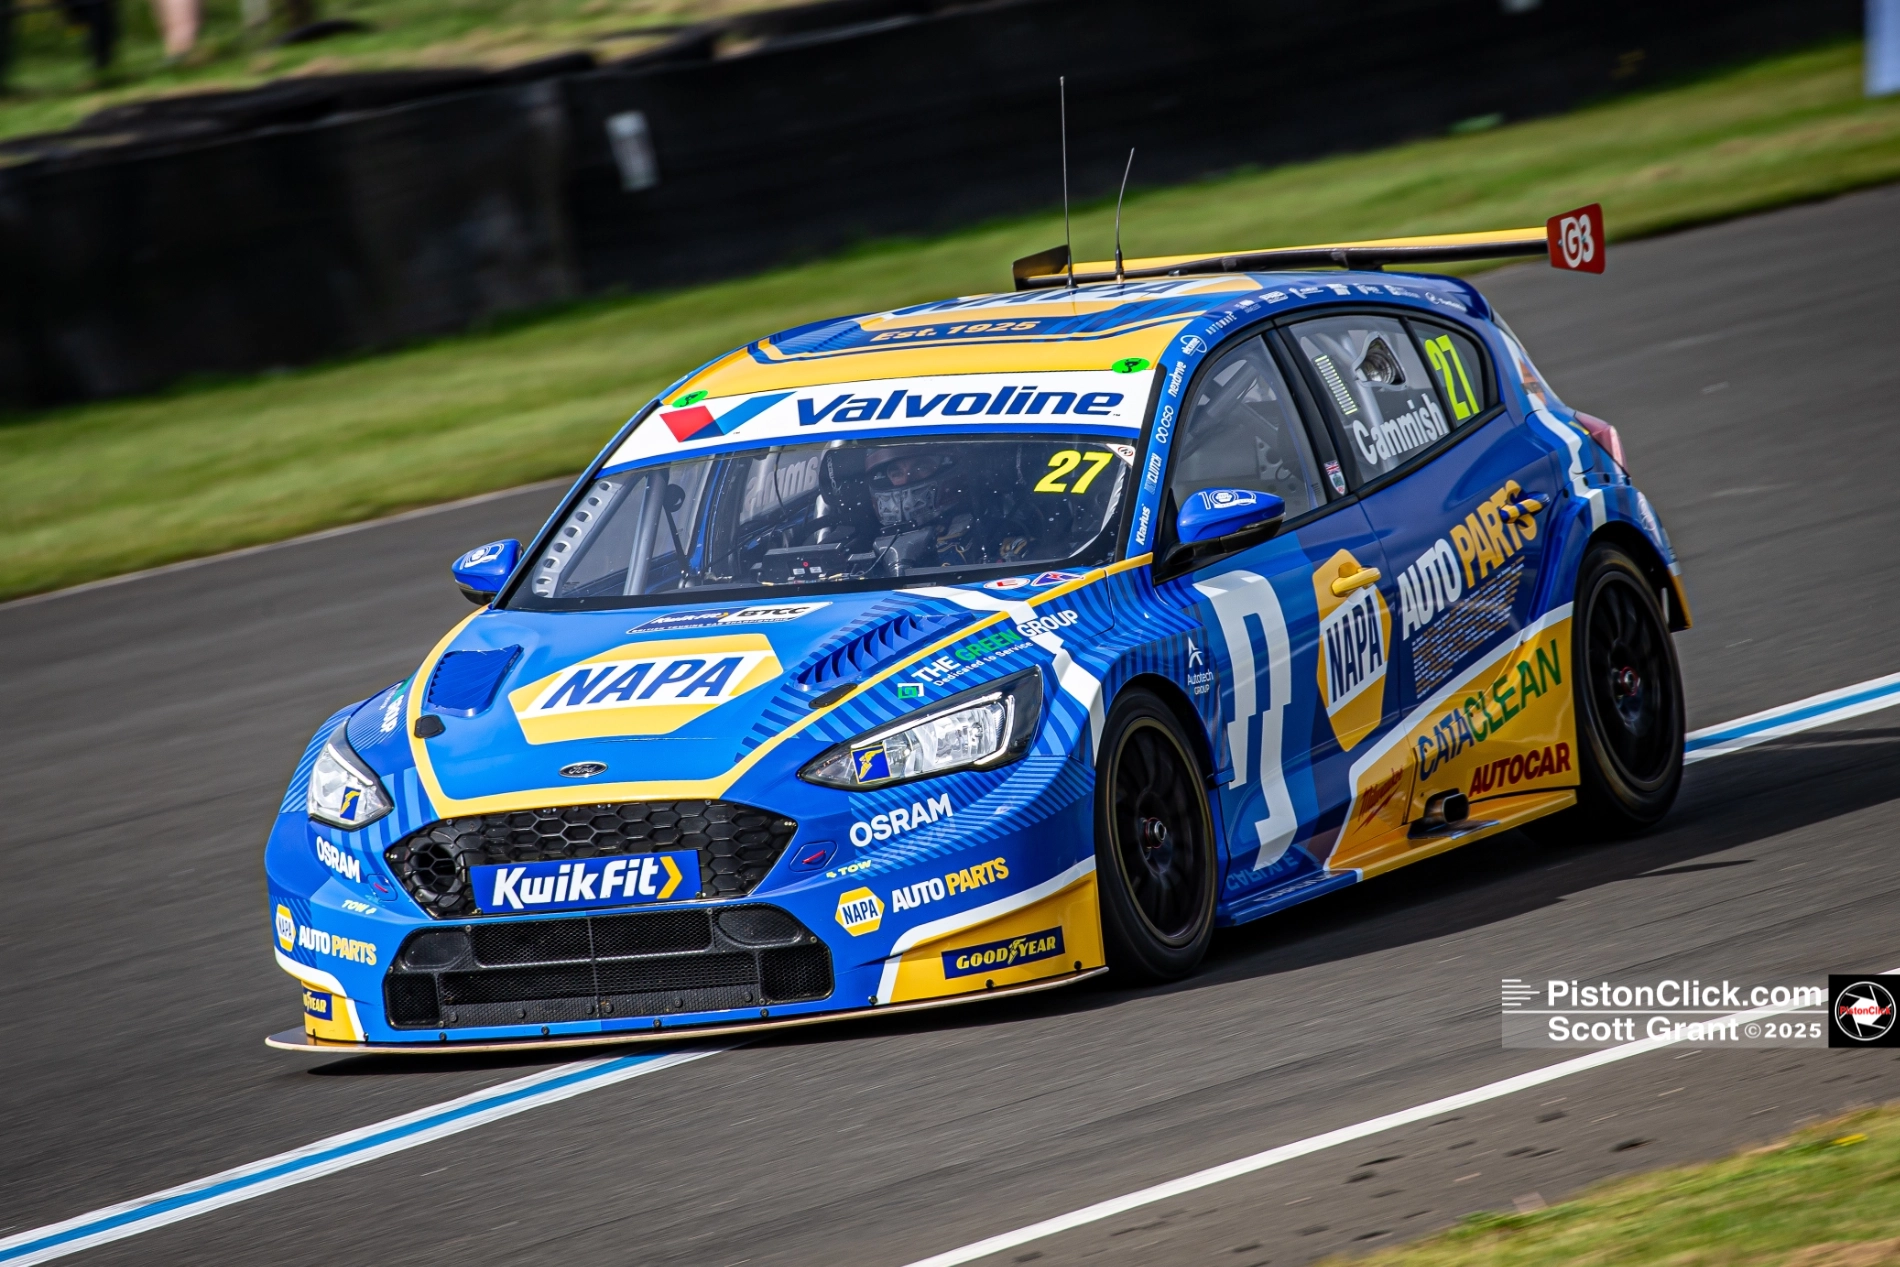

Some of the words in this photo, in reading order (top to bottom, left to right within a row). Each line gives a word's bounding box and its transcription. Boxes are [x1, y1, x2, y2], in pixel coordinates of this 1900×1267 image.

[869, 324, 936, 342] Est.
[948, 320, 1041, 335] 1925
[1167, 360, 1187, 398] nexdrive
[1425, 333, 1480, 420] 27
[797, 386, 1124, 426] Valvoline
[1352, 393, 1449, 465] Cammish
[1033, 450, 1116, 494] 27
[1135, 504, 1151, 546] Klarius
[1397, 539, 1462, 641] AUTO
[1449, 480, 1537, 589] PARTS
[737, 606, 810, 617] BTCC
[910, 655, 961, 682] THE
[954, 628, 1023, 662] GREEN
[1016, 610, 1078, 638] GROUP
[933, 660, 985, 687] Dedicated
[983, 654, 997, 664] to
[995, 641, 1034, 658] Service
[1326, 593, 1384, 703] NAPA
[540, 656, 746, 710] NAPA
[1187, 668, 1214, 686] Autotech
[1418, 639, 1562, 782] CATACLEAN
[568, 764, 597, 775] Ford
[1468, 742, 1571, 797] AUTOCAR
[849, 793, 953, 847] OSRAM
[316, 836, 361, 883] OSRAM
[838, 860, 872, 877] TOW
[891, 877, 946, 913] AUTO
[944, 857, 1010, 897] PARTS
[277, 916, 293, 941] NAPA
[341, 899, 366, 915] TOW
[841, 898, 879, 926] NAPA
[298, 925, 331, 955] AUTO
[331, 935, 377, 966] PARTS
[956, 935, 1056, 970] GOODYEAR
